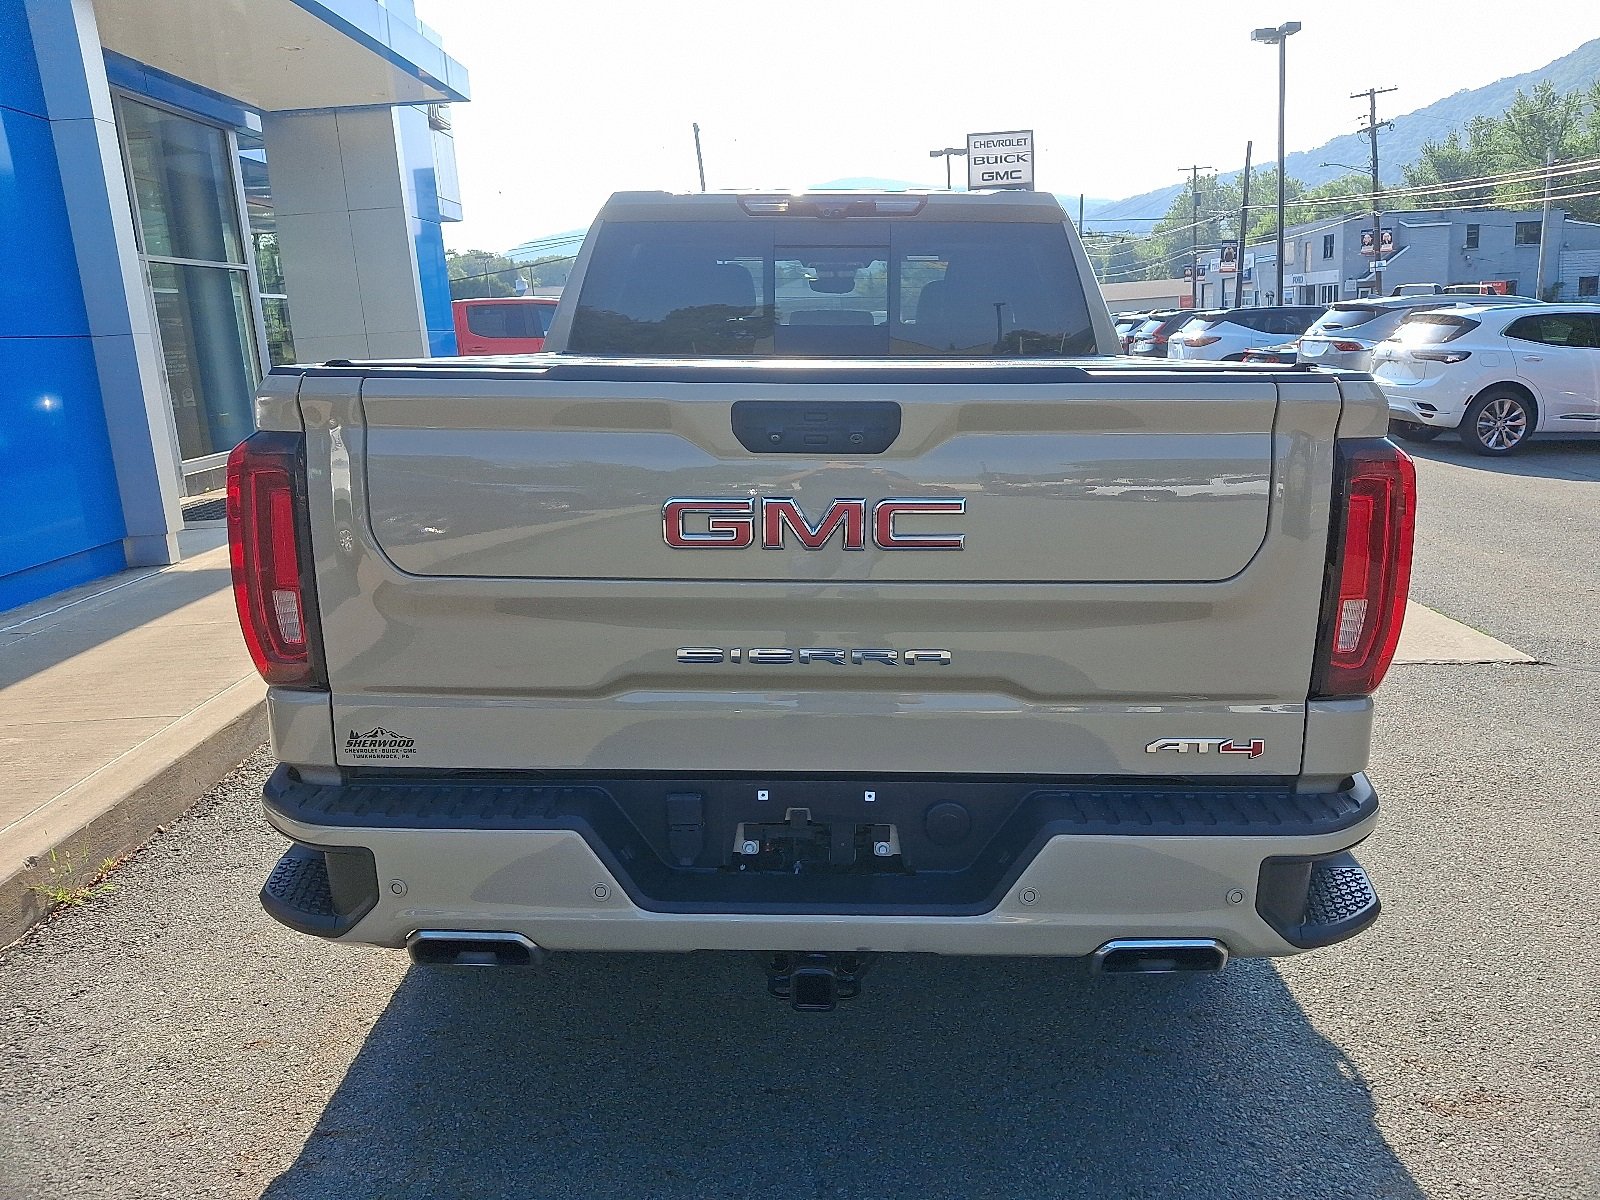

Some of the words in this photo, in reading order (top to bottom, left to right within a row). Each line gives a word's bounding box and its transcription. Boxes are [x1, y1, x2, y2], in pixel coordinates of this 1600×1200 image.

[973, 137, 1028, 149] CHEVROLET
[973, 153, 1030, 166] BUICK
[981, 169, 1022, 181] GMC
[661, 496, 967, 551] GMC
[676, 647, 952, 666] SIERRA
[345, 739, 415, 748] SHERWOOD
[1145, 738, 1265, 760] AT4
